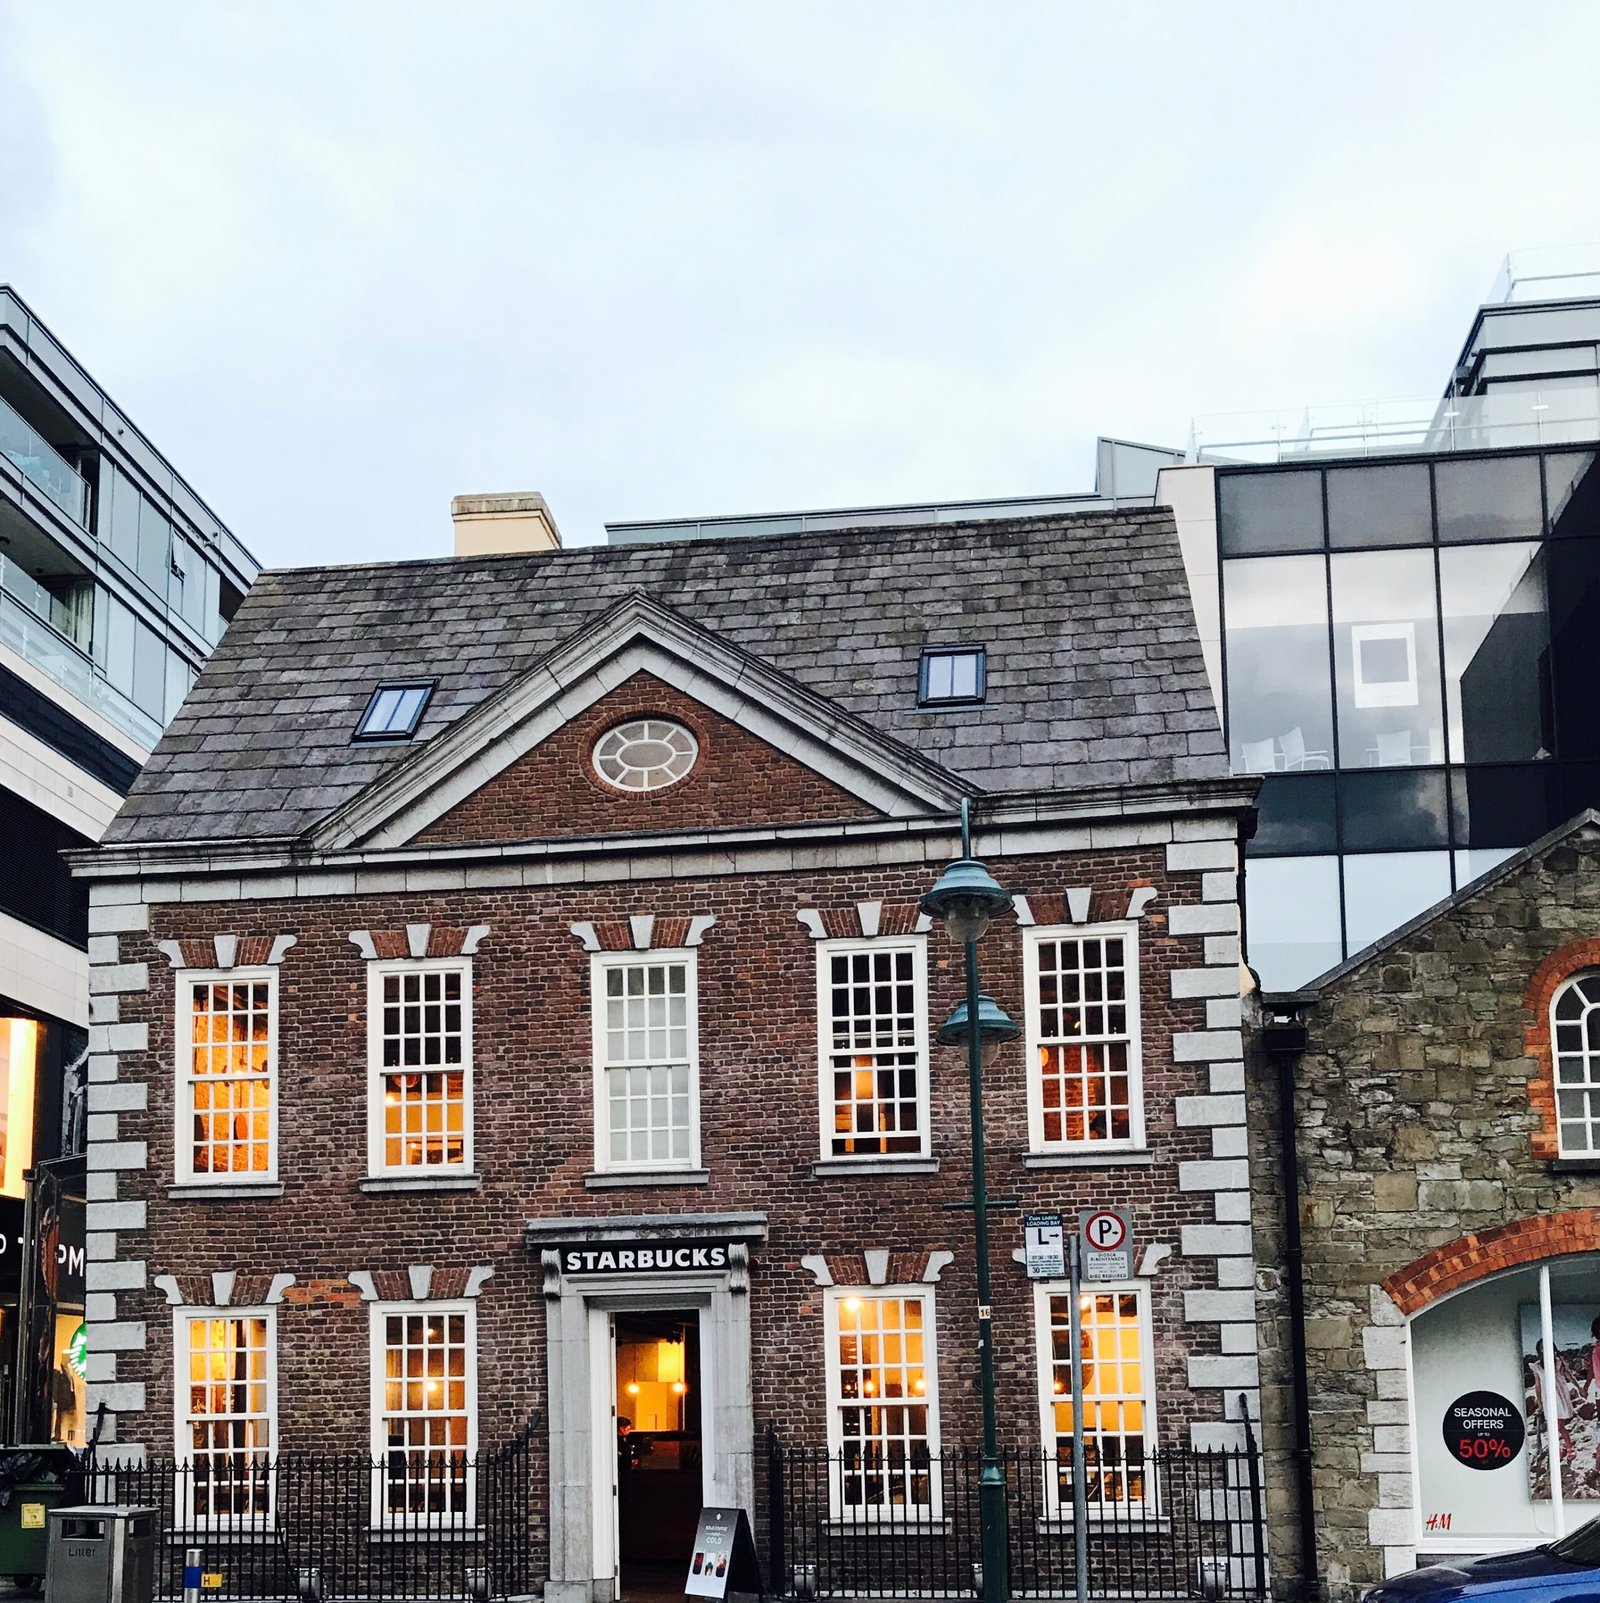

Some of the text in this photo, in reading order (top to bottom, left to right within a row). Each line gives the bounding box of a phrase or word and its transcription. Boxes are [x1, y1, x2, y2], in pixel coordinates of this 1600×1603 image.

[1038, 1228, 1049, 1245] L
[1099, 1219, 1112, 1244] P
[566, 1247, 726, 1271] STARBUCKS
[1032, 1266, 1041, 1274] 30
[980, 1308, 990, 1317] 16
[1453, 1407, 1512, 1418] SEASONAL
[1462, 1419, 1505, 1430] OFFERS
[1459, 1438, 1511, 1459] 50%
[1425, 1512, 1452, 1531] H&M
[706, 1536, 722, 1545] COLD
[68, 1545, 96, 1558] Litter
[203, 1576, 211, 1586] H
